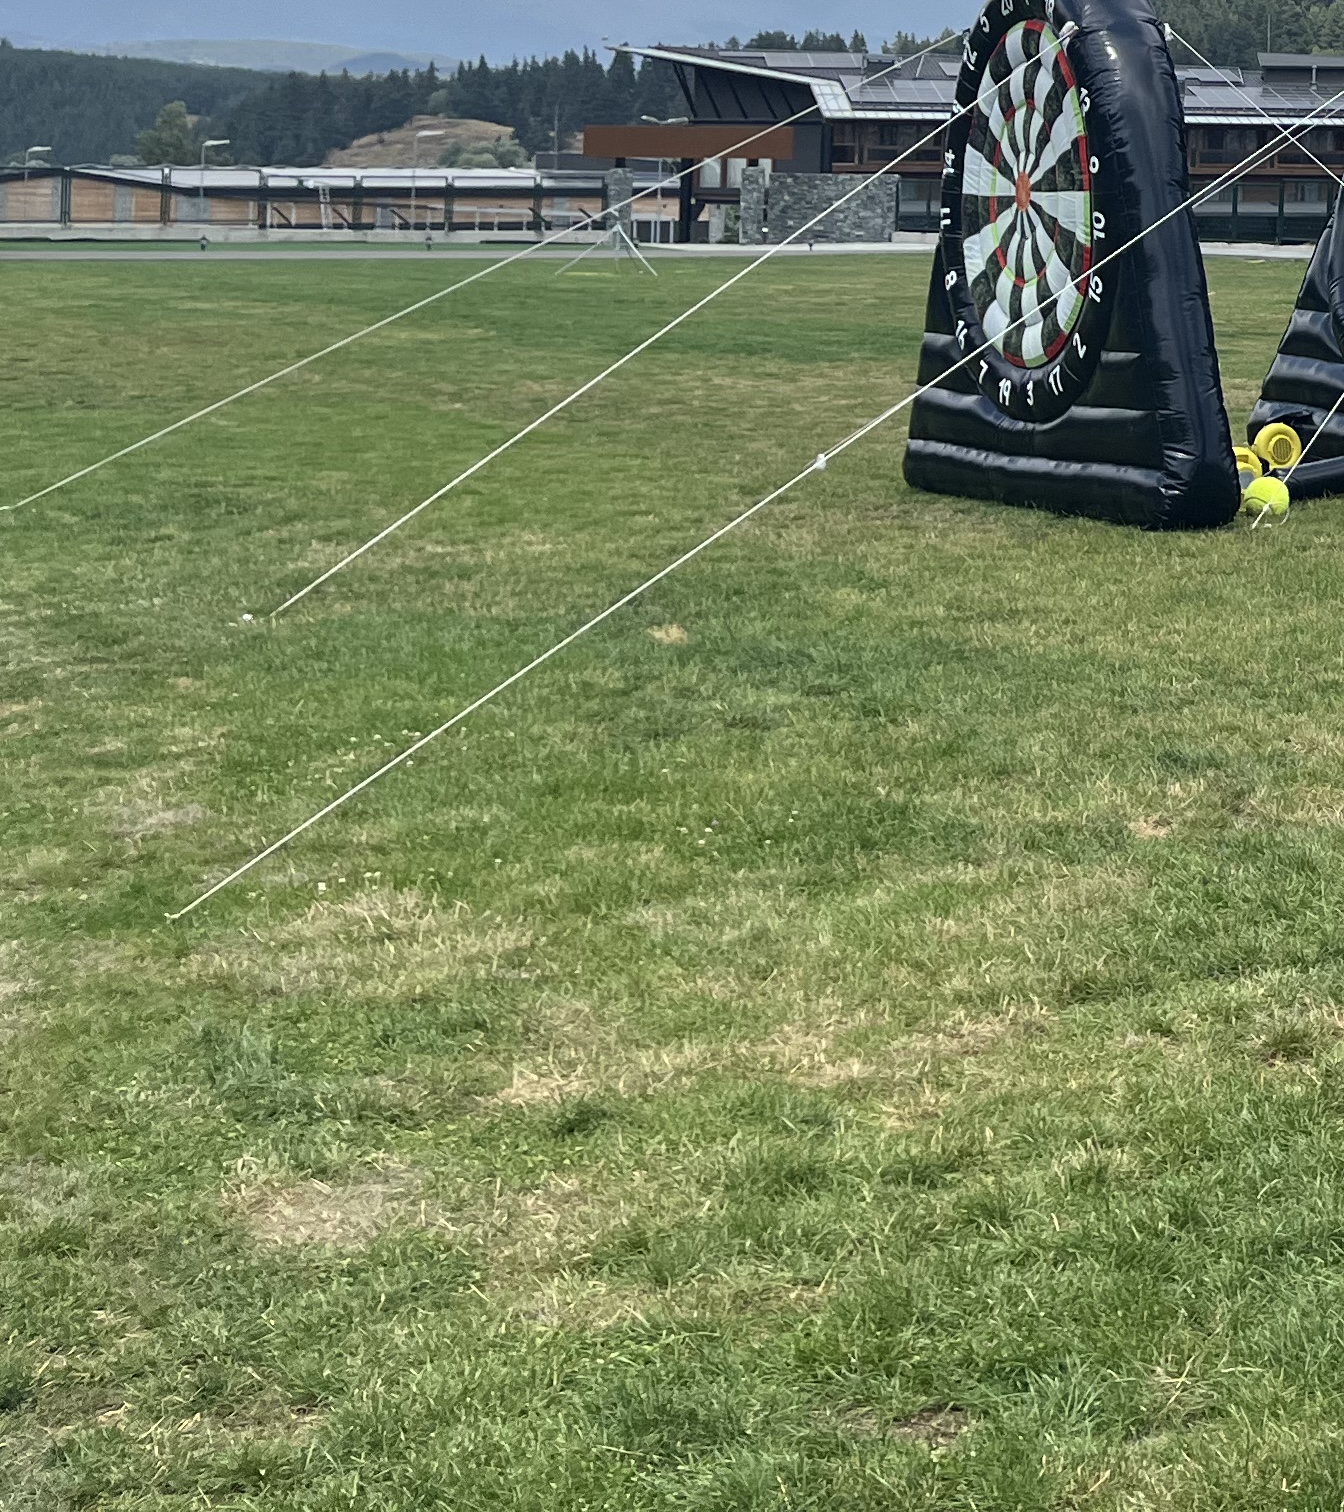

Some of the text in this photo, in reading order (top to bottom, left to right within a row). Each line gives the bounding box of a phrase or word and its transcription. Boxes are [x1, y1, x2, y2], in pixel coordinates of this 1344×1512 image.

[979, 7, 990, 33] 5
[943, 149, 955, 178] 14
[1093, 211, 1106, 240] 10
[1089, 272, 1103, 303] 15
[1073, 332, 1087, 359] 2
[978, 360, 988, 384] 7
[1049, 365, 1064, 396] 17
[998, 378, 1011, 406] 19
[1026, 380, 1034, 406] 3
